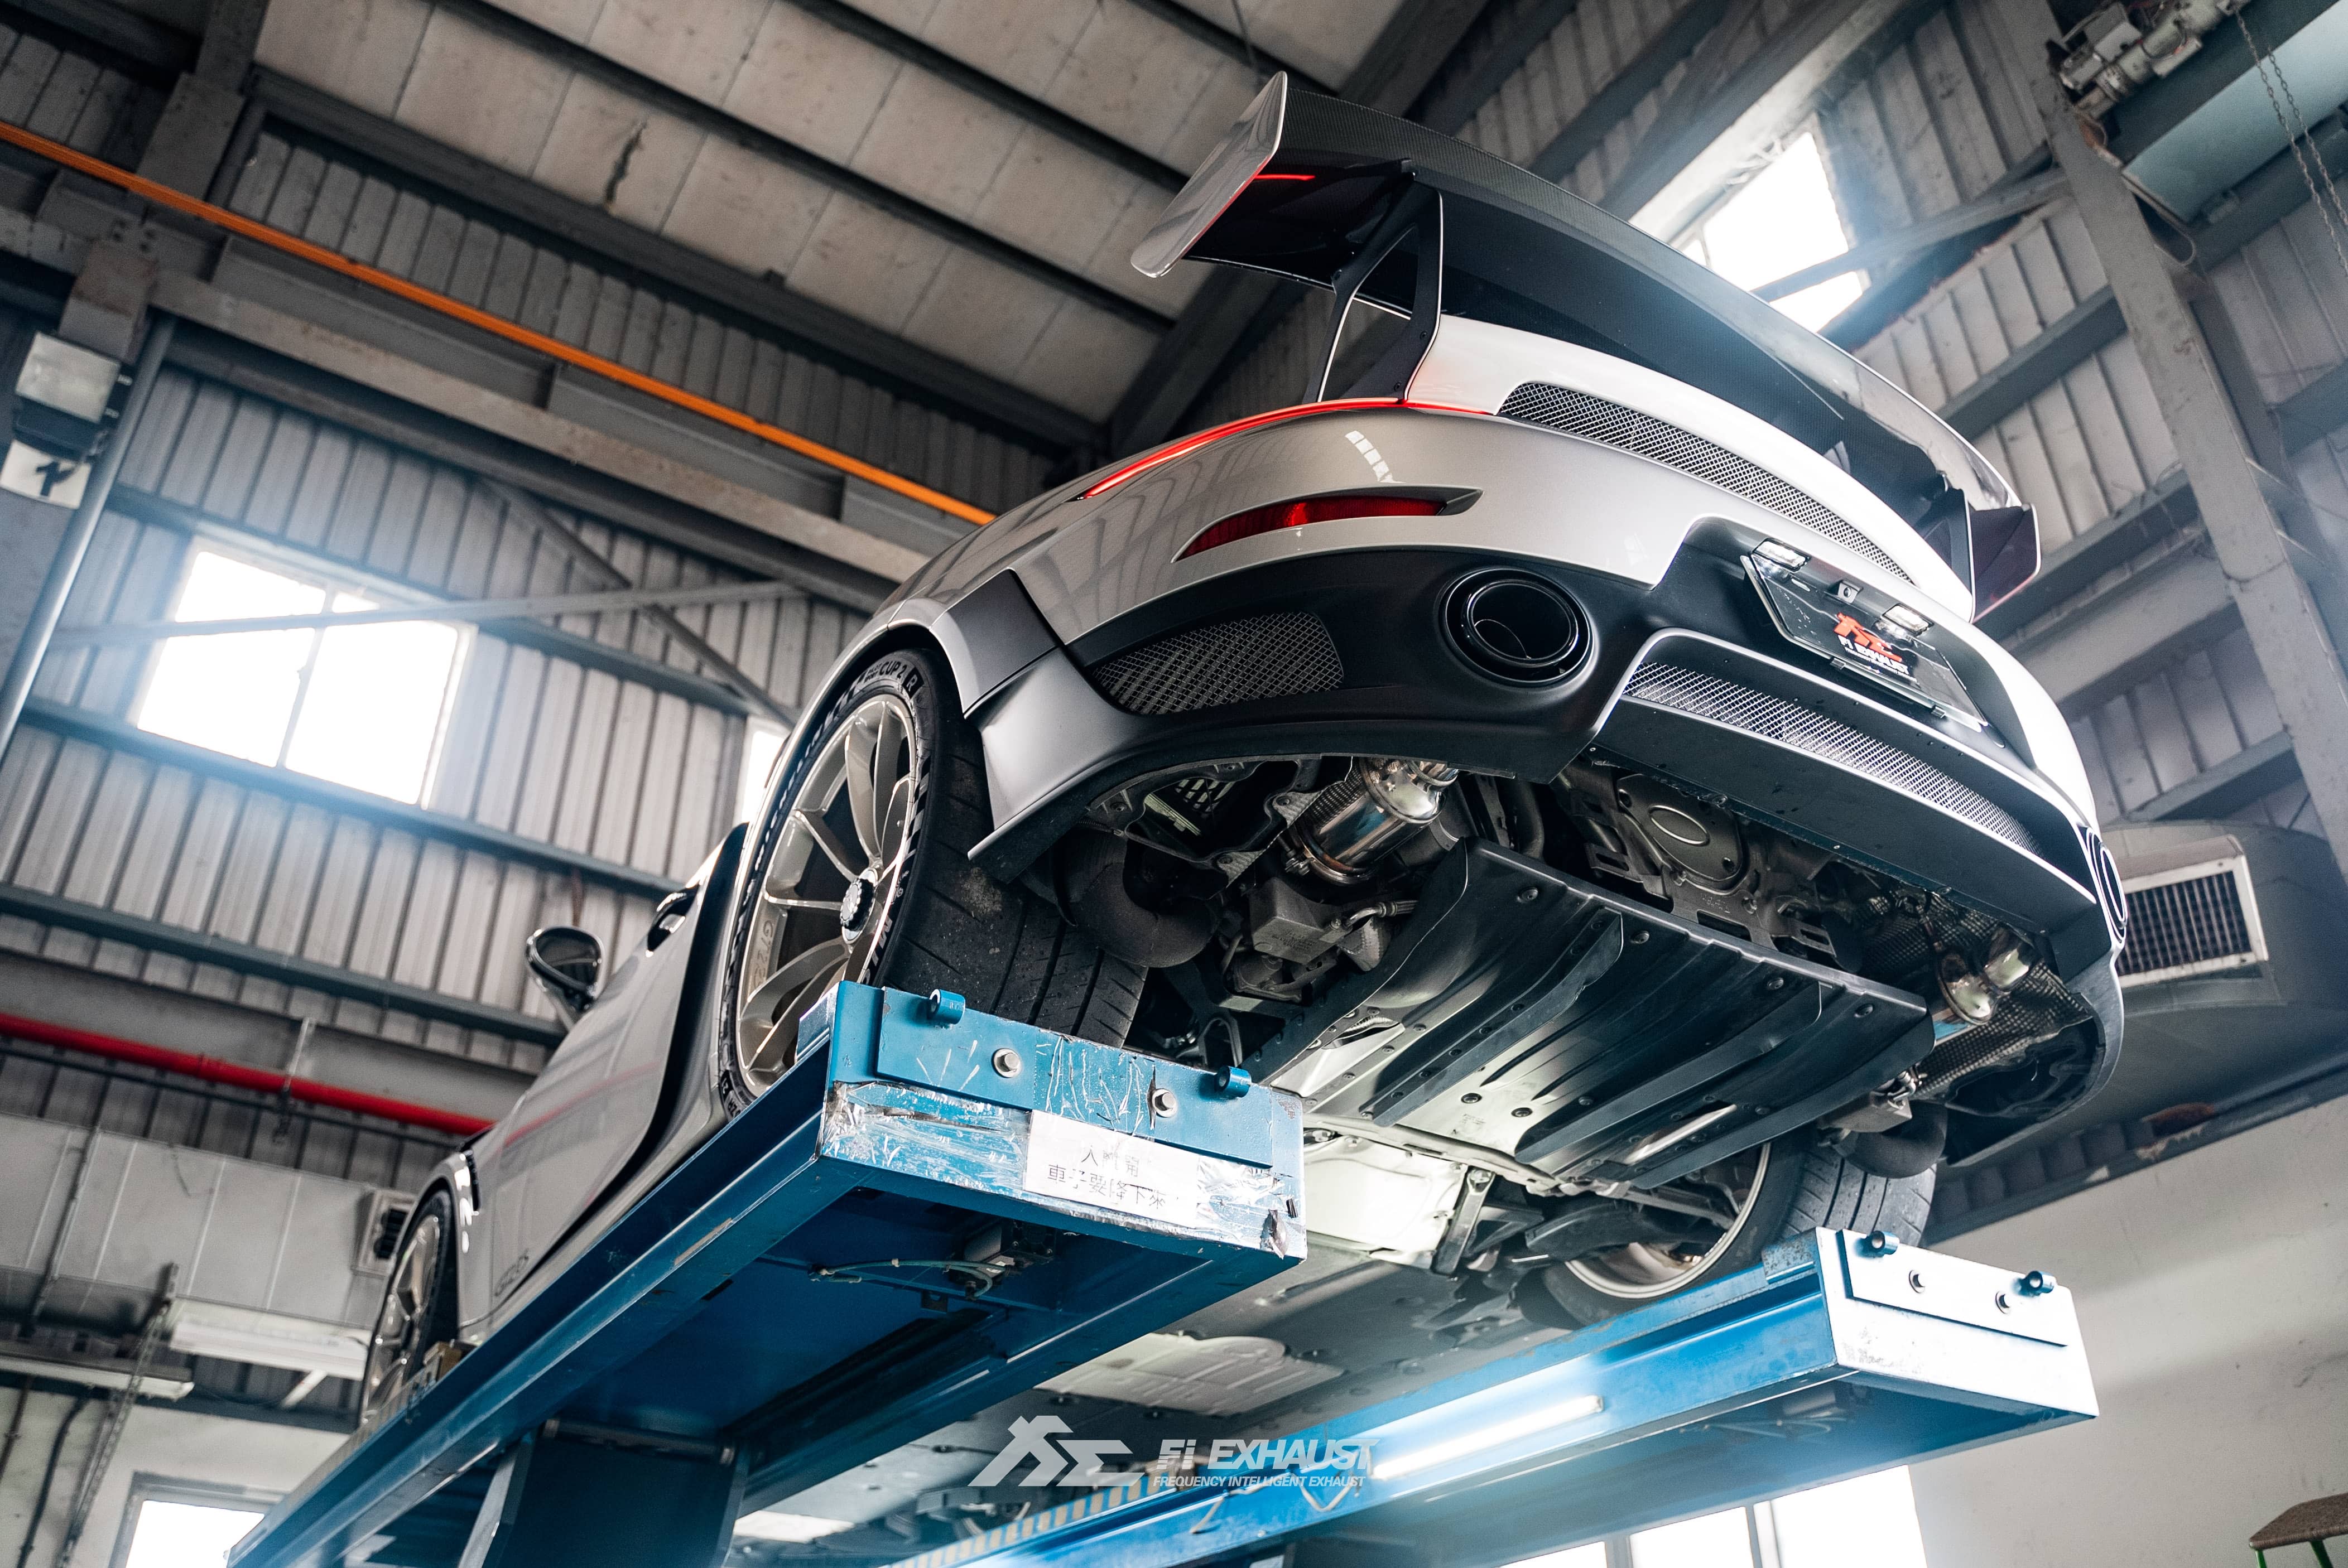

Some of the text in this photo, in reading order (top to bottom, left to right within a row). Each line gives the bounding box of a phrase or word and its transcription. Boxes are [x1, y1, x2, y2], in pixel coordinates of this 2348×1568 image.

[879, 660, 902, 676] CUP
[896, 664, 907, 679] 2
[906, 674, 918, 692] R
